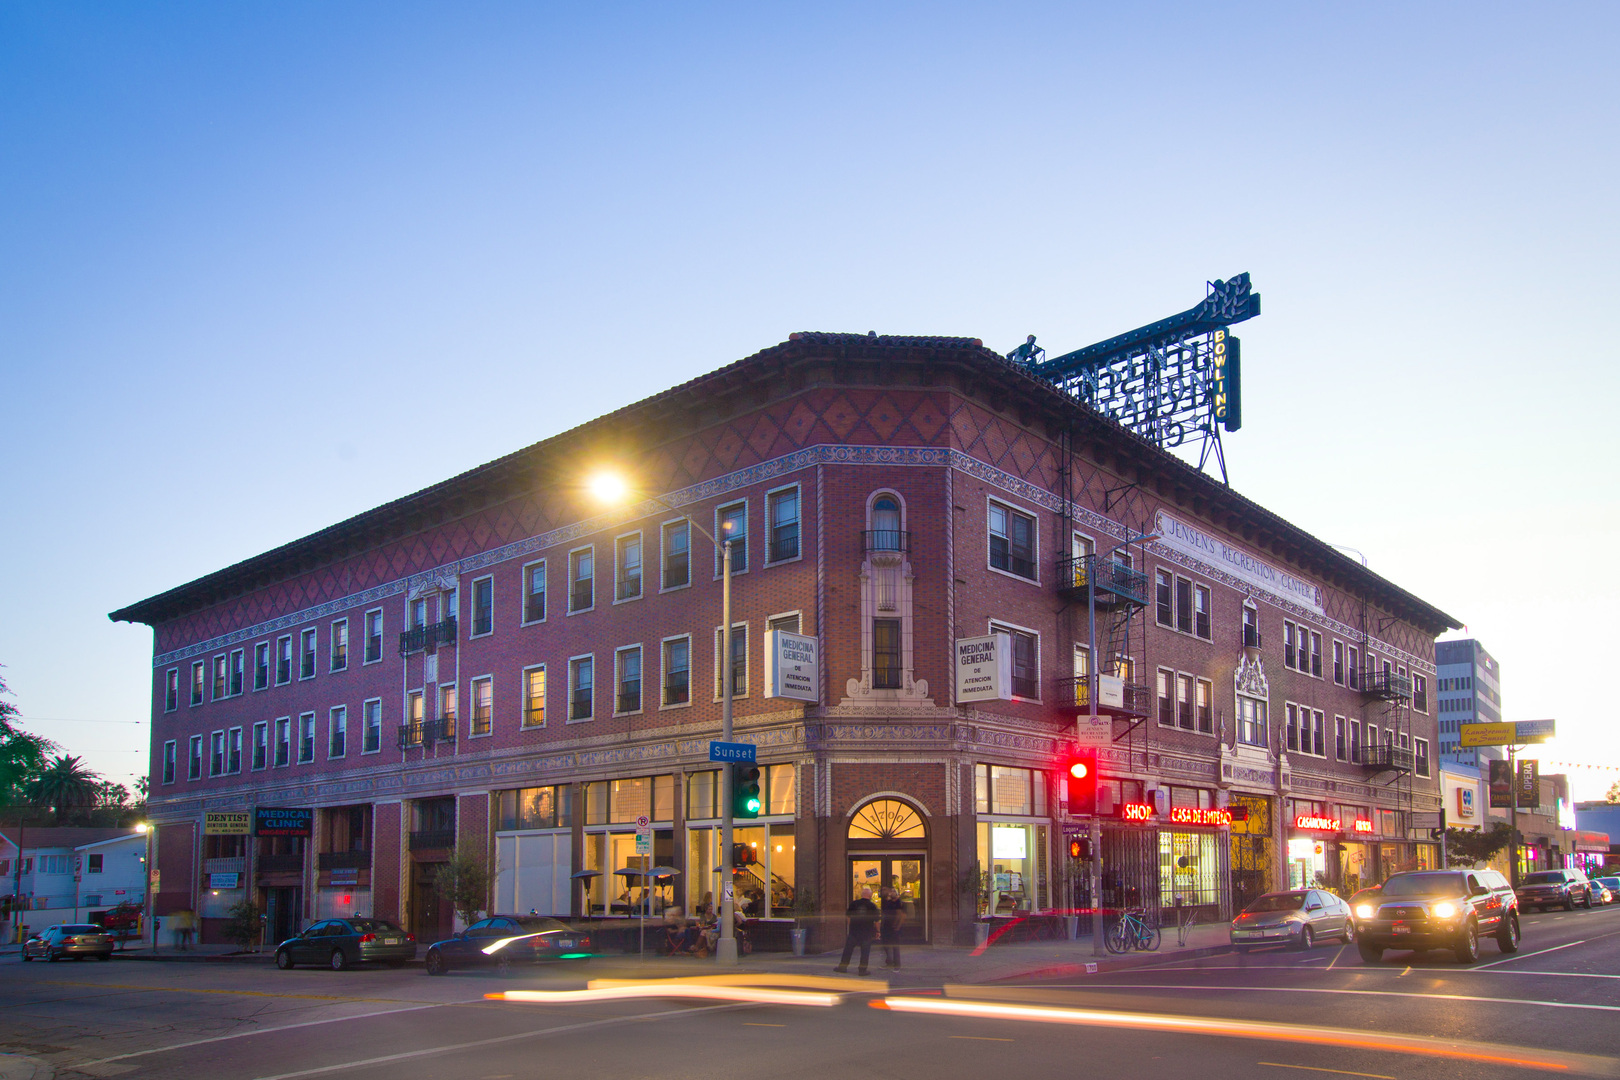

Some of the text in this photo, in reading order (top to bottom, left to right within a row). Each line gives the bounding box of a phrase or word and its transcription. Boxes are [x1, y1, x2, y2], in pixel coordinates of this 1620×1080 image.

[1213, 330, 1227, 418] BOWLING
[1169, 520, 1312, 599] JENSEN'S RECREATION CENTER
[781, 638, 814, 653] MEDICINA
[960, 641, 995, 655] MEDICINA
[783, 649, 813, 663] GENERAL
[961, 652, 994, 665] GENERAL
[786, 673, 811, 682] ATENCION
[964, 676, 991, 684] ATENCION
[784, 683, 812, 692] INMEDIATA
[962, 685, 993, 693] INMEDIATA
[1478, 734, 1507, 742] Sunset
[714, 745, 752, 759] Sunset
[207, 814, 249, 822] DENTIST
[258, 810, 312, 819] MEDICAL
[870, 811, 904, 823] 1700
[1126, 804, 1151, 820] SHOP
[1171, 807, 1191, 823] CASA
[1192, 809, 1202, 824] DE
[265, 819, 304, 828] CLINIC
